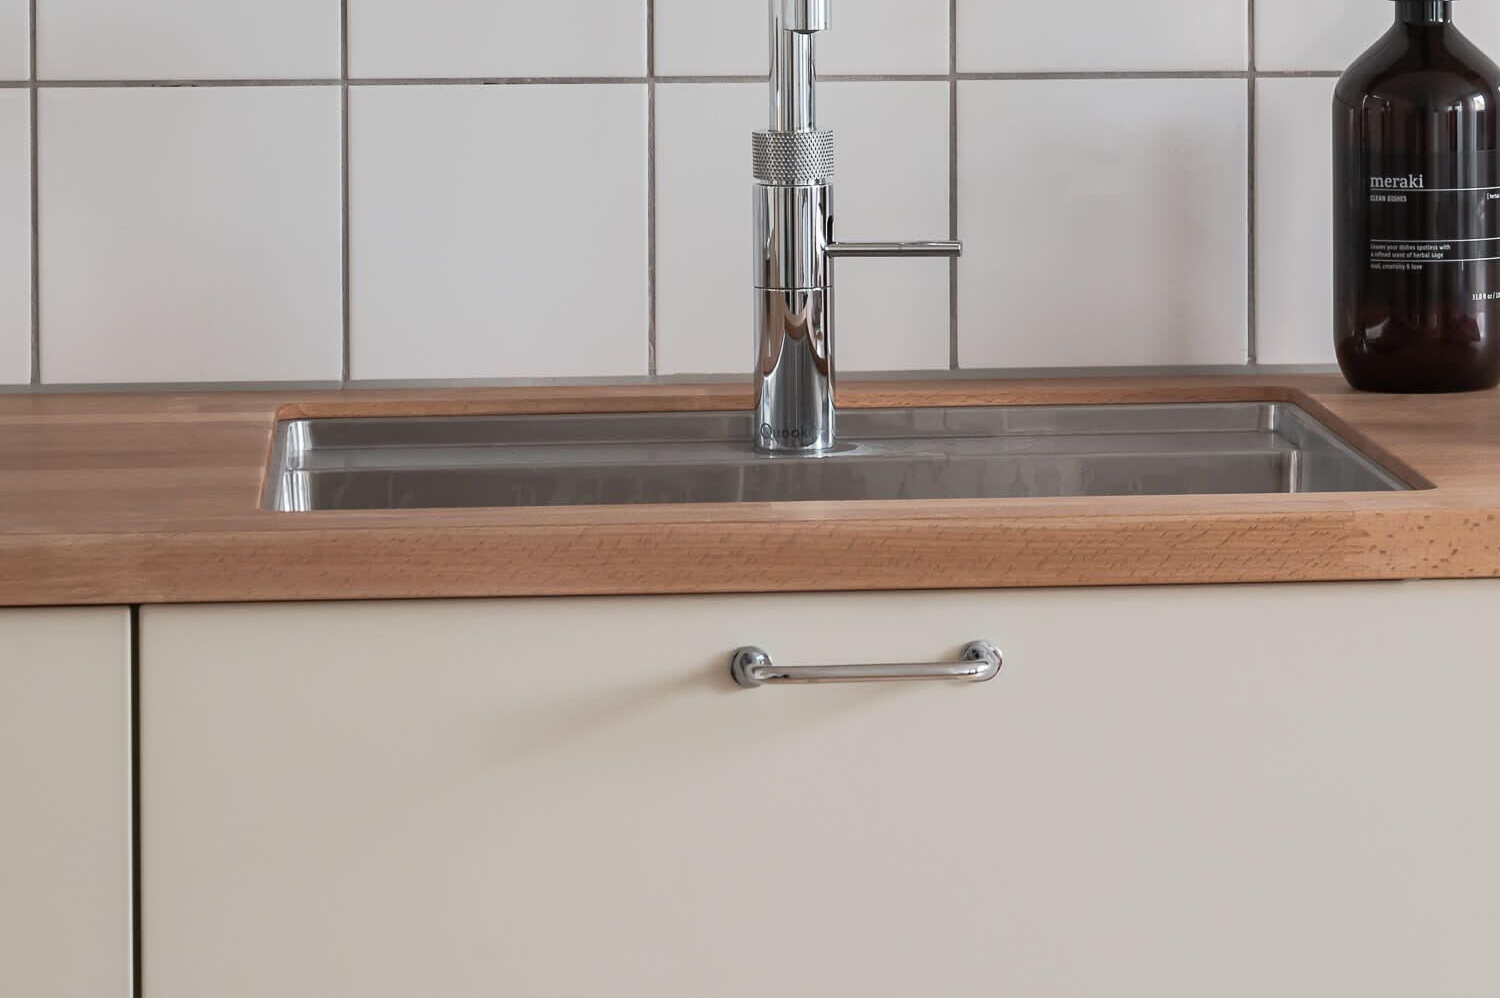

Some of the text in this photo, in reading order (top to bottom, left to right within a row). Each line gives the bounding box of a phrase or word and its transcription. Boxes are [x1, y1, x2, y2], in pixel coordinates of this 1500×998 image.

[1370, 174, 1424, 188] meraki
[1370, 194, 1386, 202] CLEAN
[1438, 243, 1451, 251] with
